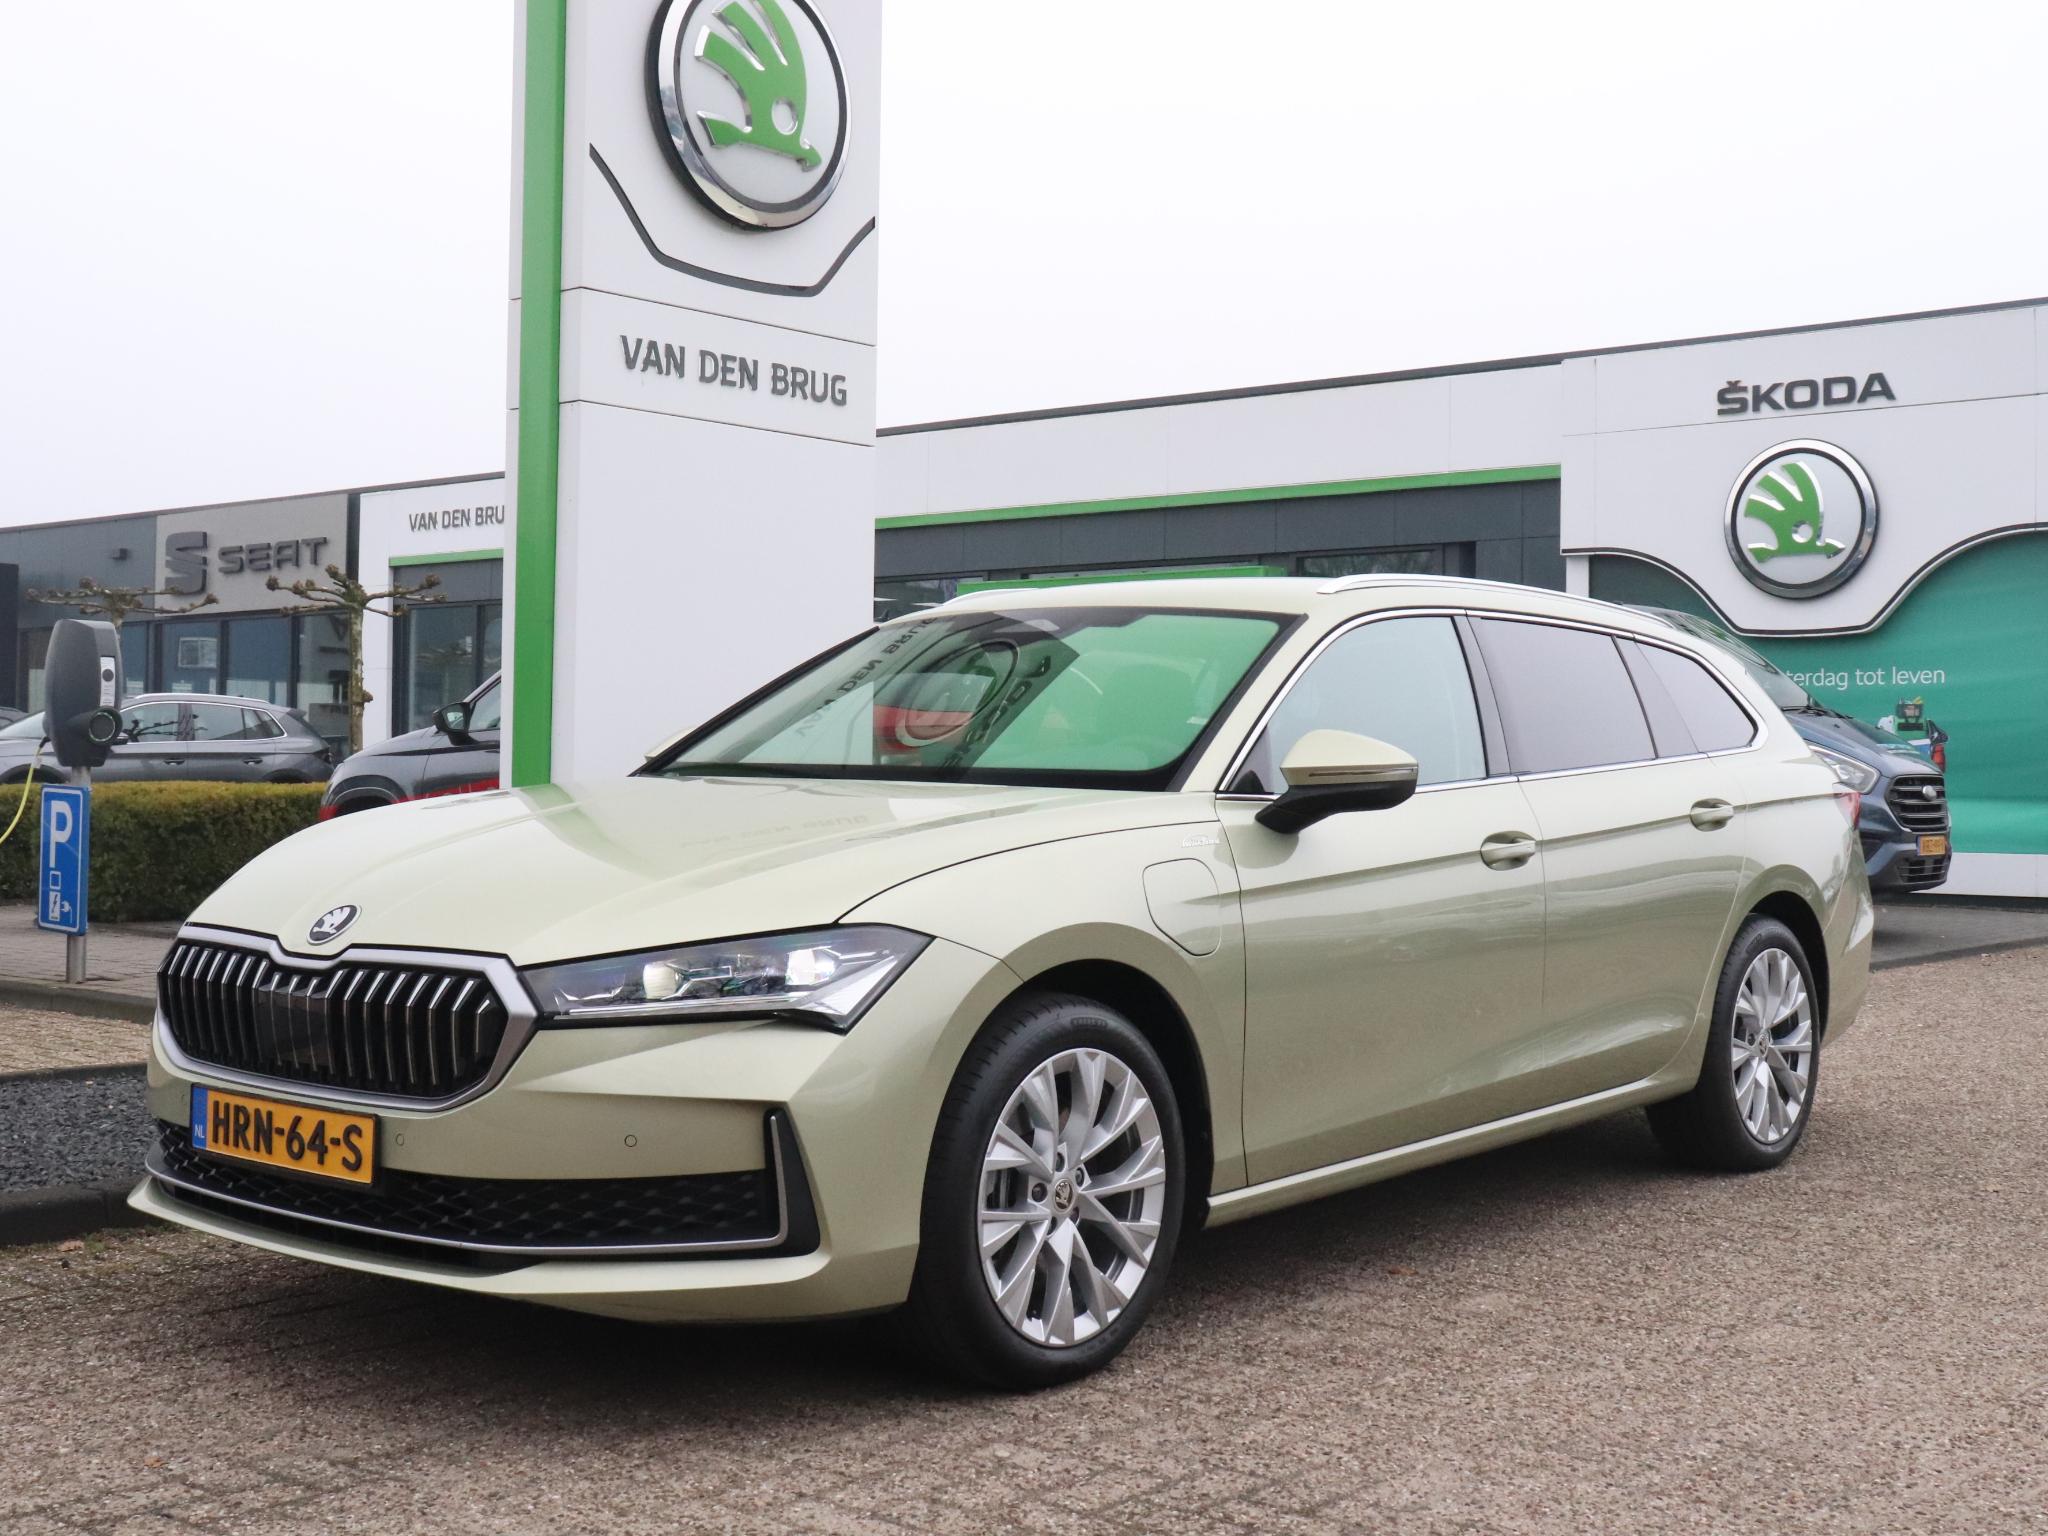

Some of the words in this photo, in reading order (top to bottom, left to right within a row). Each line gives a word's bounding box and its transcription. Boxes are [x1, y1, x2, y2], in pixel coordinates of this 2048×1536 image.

[620, 335, 686, 379] VAN
[699, 349, 759, 391] DEN
[771, 362, 847, 407] BRUG
[1717, 372, 1897, 416] ŠKODA
[409, 511, 438, 532] VAN
[441, 508, 471, 529] DEN
[218, 536, 328, 575] SEAT
[1855, 668, 1886, 686] tot
[1892, 666, 1946, 685] leven
[49, 799, 73, 868] P
[194, 1124, 205, 1139] NL
[212, 1100, 363, 1172] HRN-64-S
